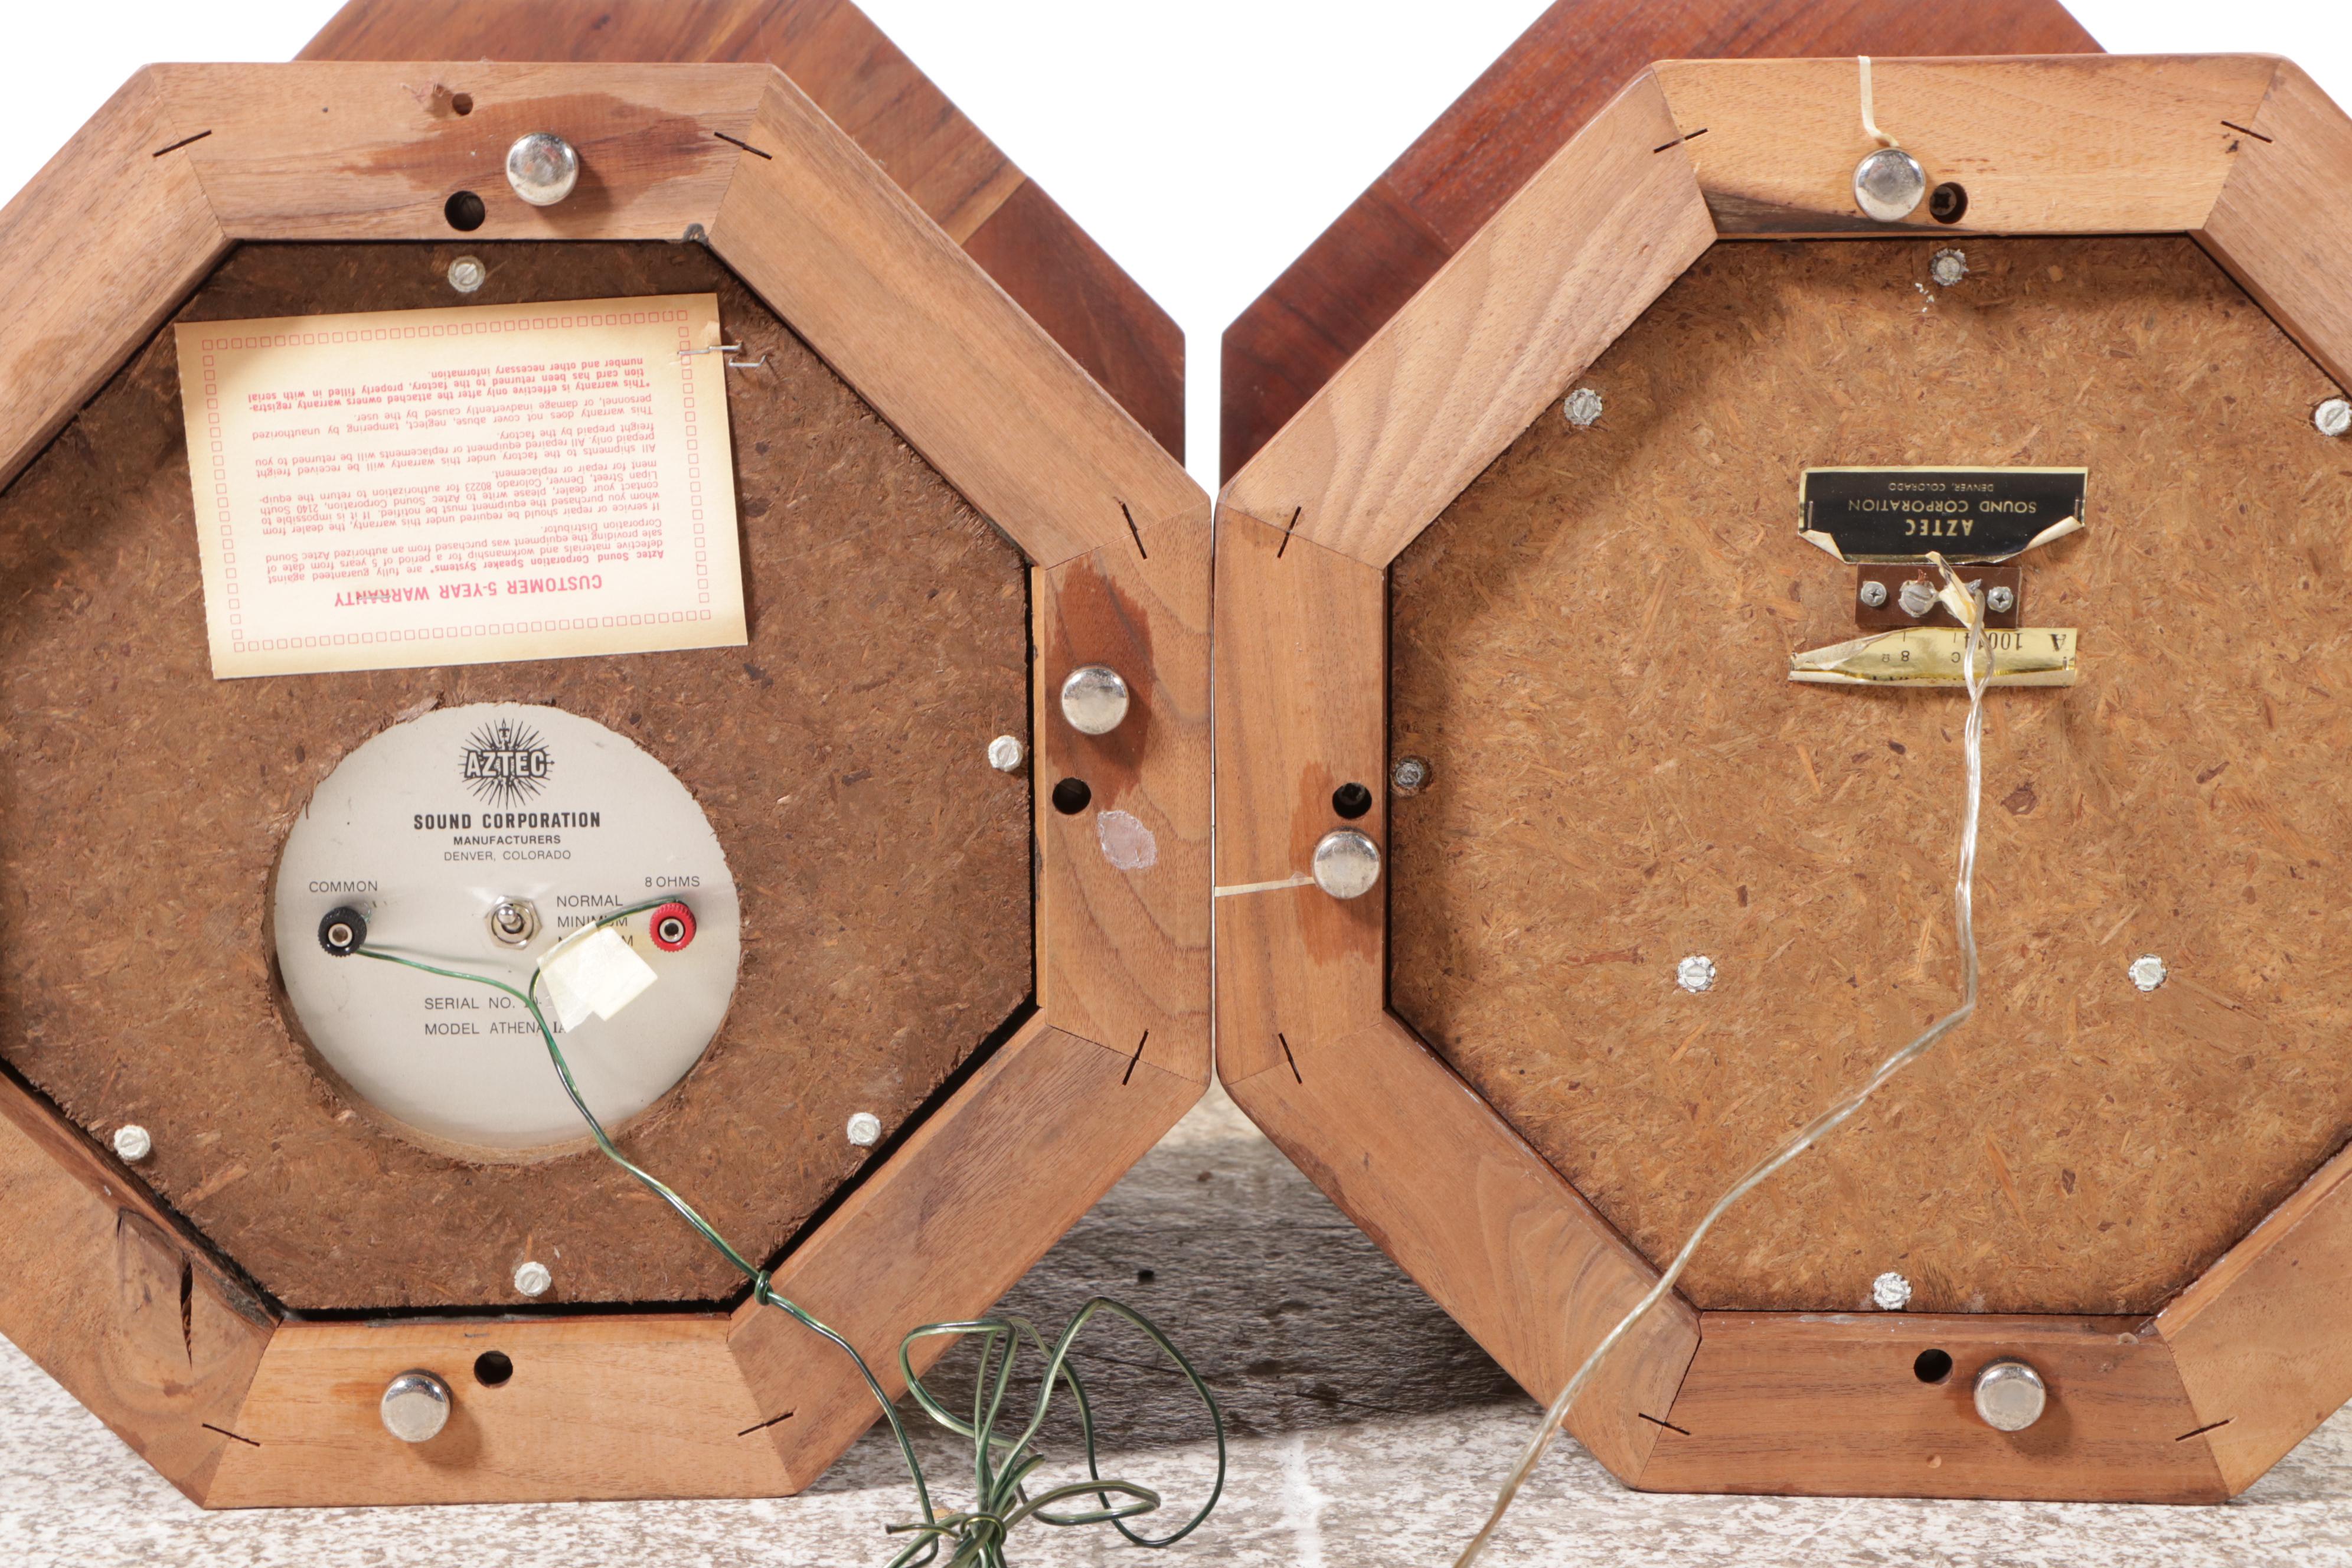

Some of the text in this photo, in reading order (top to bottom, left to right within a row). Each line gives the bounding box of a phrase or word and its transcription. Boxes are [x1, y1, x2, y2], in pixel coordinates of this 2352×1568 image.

[428, 357, 643, 380] number and other necessary information.
[248, 368, 645, 403] tion card has been returned to the factory, properly filled in with serial
[512, 384, 557, 396] effective
[561, 383, 570, 393] is
[574, 378, 619, 392] warranty
[437, 391, 453, 401] the
[458, 389, 482, 400] after
[486, 385, 508, 397] only
[296, 396, 341, 410] warranty
[346, 396, 382, 405] owners
[387, 392, 432, 404] attached
[249, 399, 292, 413] registra-
[466, 400, 533, 416] inadvertently
[538, 397, 578, 411] damage
[406, 408, 417, 420] by
[424, 407, 460, 419] caused
[550, 410, 574, 421] does
[580, 405, 624, 419] warranty
[631, 405, 652, 416] This
[384, 411, 401, 422] the
[492, 414, 520, 423] cover
[527, 413, 543, 423] not
[327, 424, 339, 436] by
[347, 420, 399, 435] tampering
[252, 427, 320, 440] unauthorized
[256, 442, 656, 478] All shipments to the factory under this warranty will be received freight
[631, 460, 656, 471] ment
[577, 461, 607, 474] repair
[612, 462, 626, 472] for
[629, 468, 657, 481] Lipan
[445, 484, 459, 493] for
[465, 481, 491, 492] 80223
[496, 478, 541, 489] Colorado
[593, 481, 615, 492] your
[620, 481, 658, 492] contact
[1889, 482, 1994, 492] DENVER, COLORADO
[319, 491, 351, 502] return
[357, 489, 367, 499] to
[372, 485, 440, 498] authorization
[482, 491, 508, 501] write
[513, 486, 546, 499] please
[297, 493, 314, 503] the
[393, 496, 425, 507] Sound
[432, 494, 460, 505] Aztec
[466, 493, 476, 502] to
[260, 505, 290, 516] South
[296, 503, 318, 514] 2140
[563, 504, 592, 517] repair
[612, 502, 648, 513] service
[651, 501, 659, 511] If
[1848, 499, 2037, 513] SOUND CORPORATION
[459, 509, 502, 524] required
[507, 511, 520, 520] be
[524, 508, 558, 519] should
[401, 517, 421, 527] this
[425, 515, 455, 525] under
[603, 515, 661, 530] Corporation
[262, 526, 286, 537] from
[291, 524, 324, 535] dealer
[328, 522, 345, 532] the
[1905, 519, 1974, 536] AZTEC
[571, 533, 588, 543] the
[591, 528, 638, 542] providing
[642, 528, 662, 539] sale
[435, 538, 488, 553] purchased
[491, 538, 510, 547] was
[514, 533, 569, 547] equipment
[334, 547, 388, 559] authorized
[407, 544, 431, 554] from
[266, 553, 298, 564] Sound
[302, 550, 330, 561] Aztec
[530, 553, 589, 567] Corporation
[597, 552, 629, 563] Sound
[636, 550, 664, 560] Aztec
[482, 557, 524, 570] Speaker
[312, 567, 369, 582] guaranteed
[376, 565, 399, 577] fully
[267, 571, 305, 584] against
[334, 574, 602, 606] CUSTOMER 5-YEAR WARRANTY
[2049, 633, 2067, 652] A
[1900, 651, 1910, 662] 8
[464, 750, 547, 778] AZTEC
[414, 812, 600, 829] SOUND CORPORATION
[453, 835, 561, 845] MANUFACTURERS
[444, 850, 571, 862] DENVER, COLORADO
[309, 880, 378, 893] COMMON
[645, 876, 700, 887] 8 OHMS
[557, 895, 623, 907] NORMAL
[424, 997, 479, 1010] SERIAL
[489, 997, 515, 1008] NO.
[425, 1023, 479, 1035] MODEL
